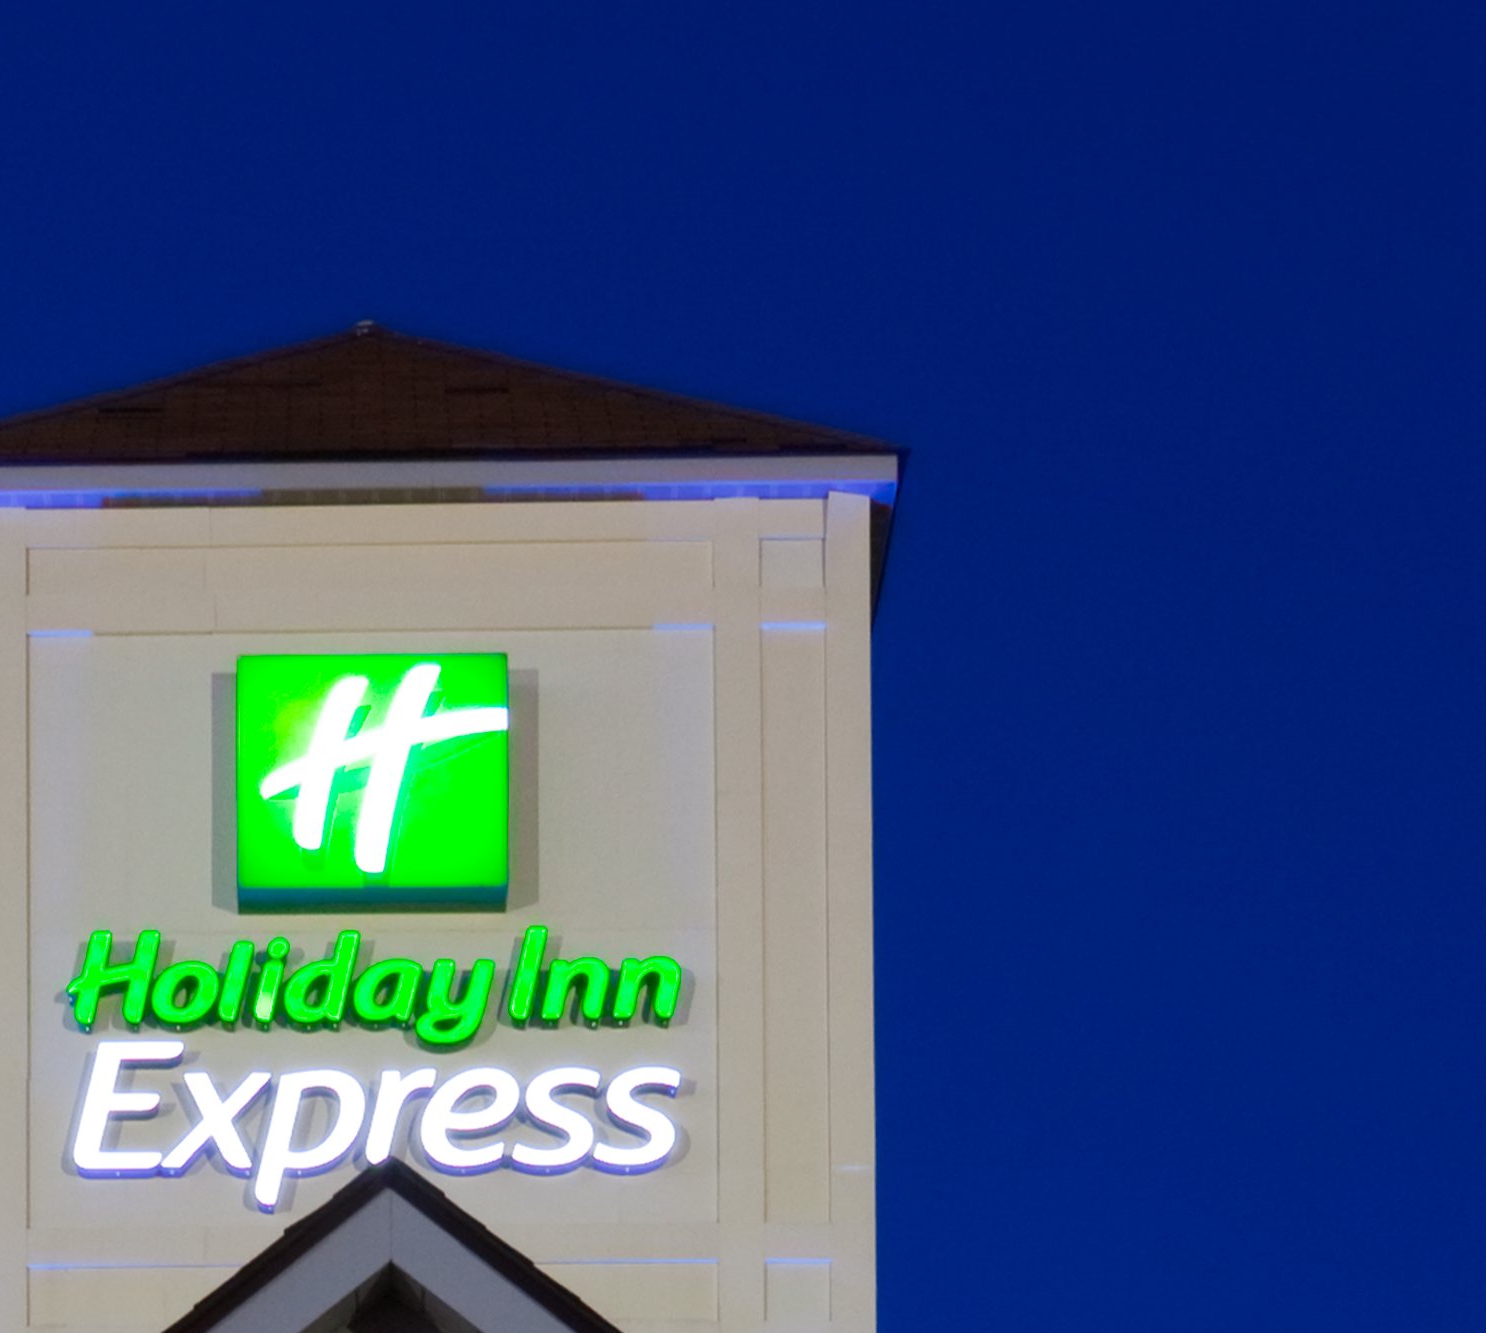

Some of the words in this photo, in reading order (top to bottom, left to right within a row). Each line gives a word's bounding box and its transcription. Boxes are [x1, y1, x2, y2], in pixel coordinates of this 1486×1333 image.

[66, 929, 496, 1045] Holiday
[508, 925, 683, 1025] Inn
[72, 1040, 683, 1212] Express
